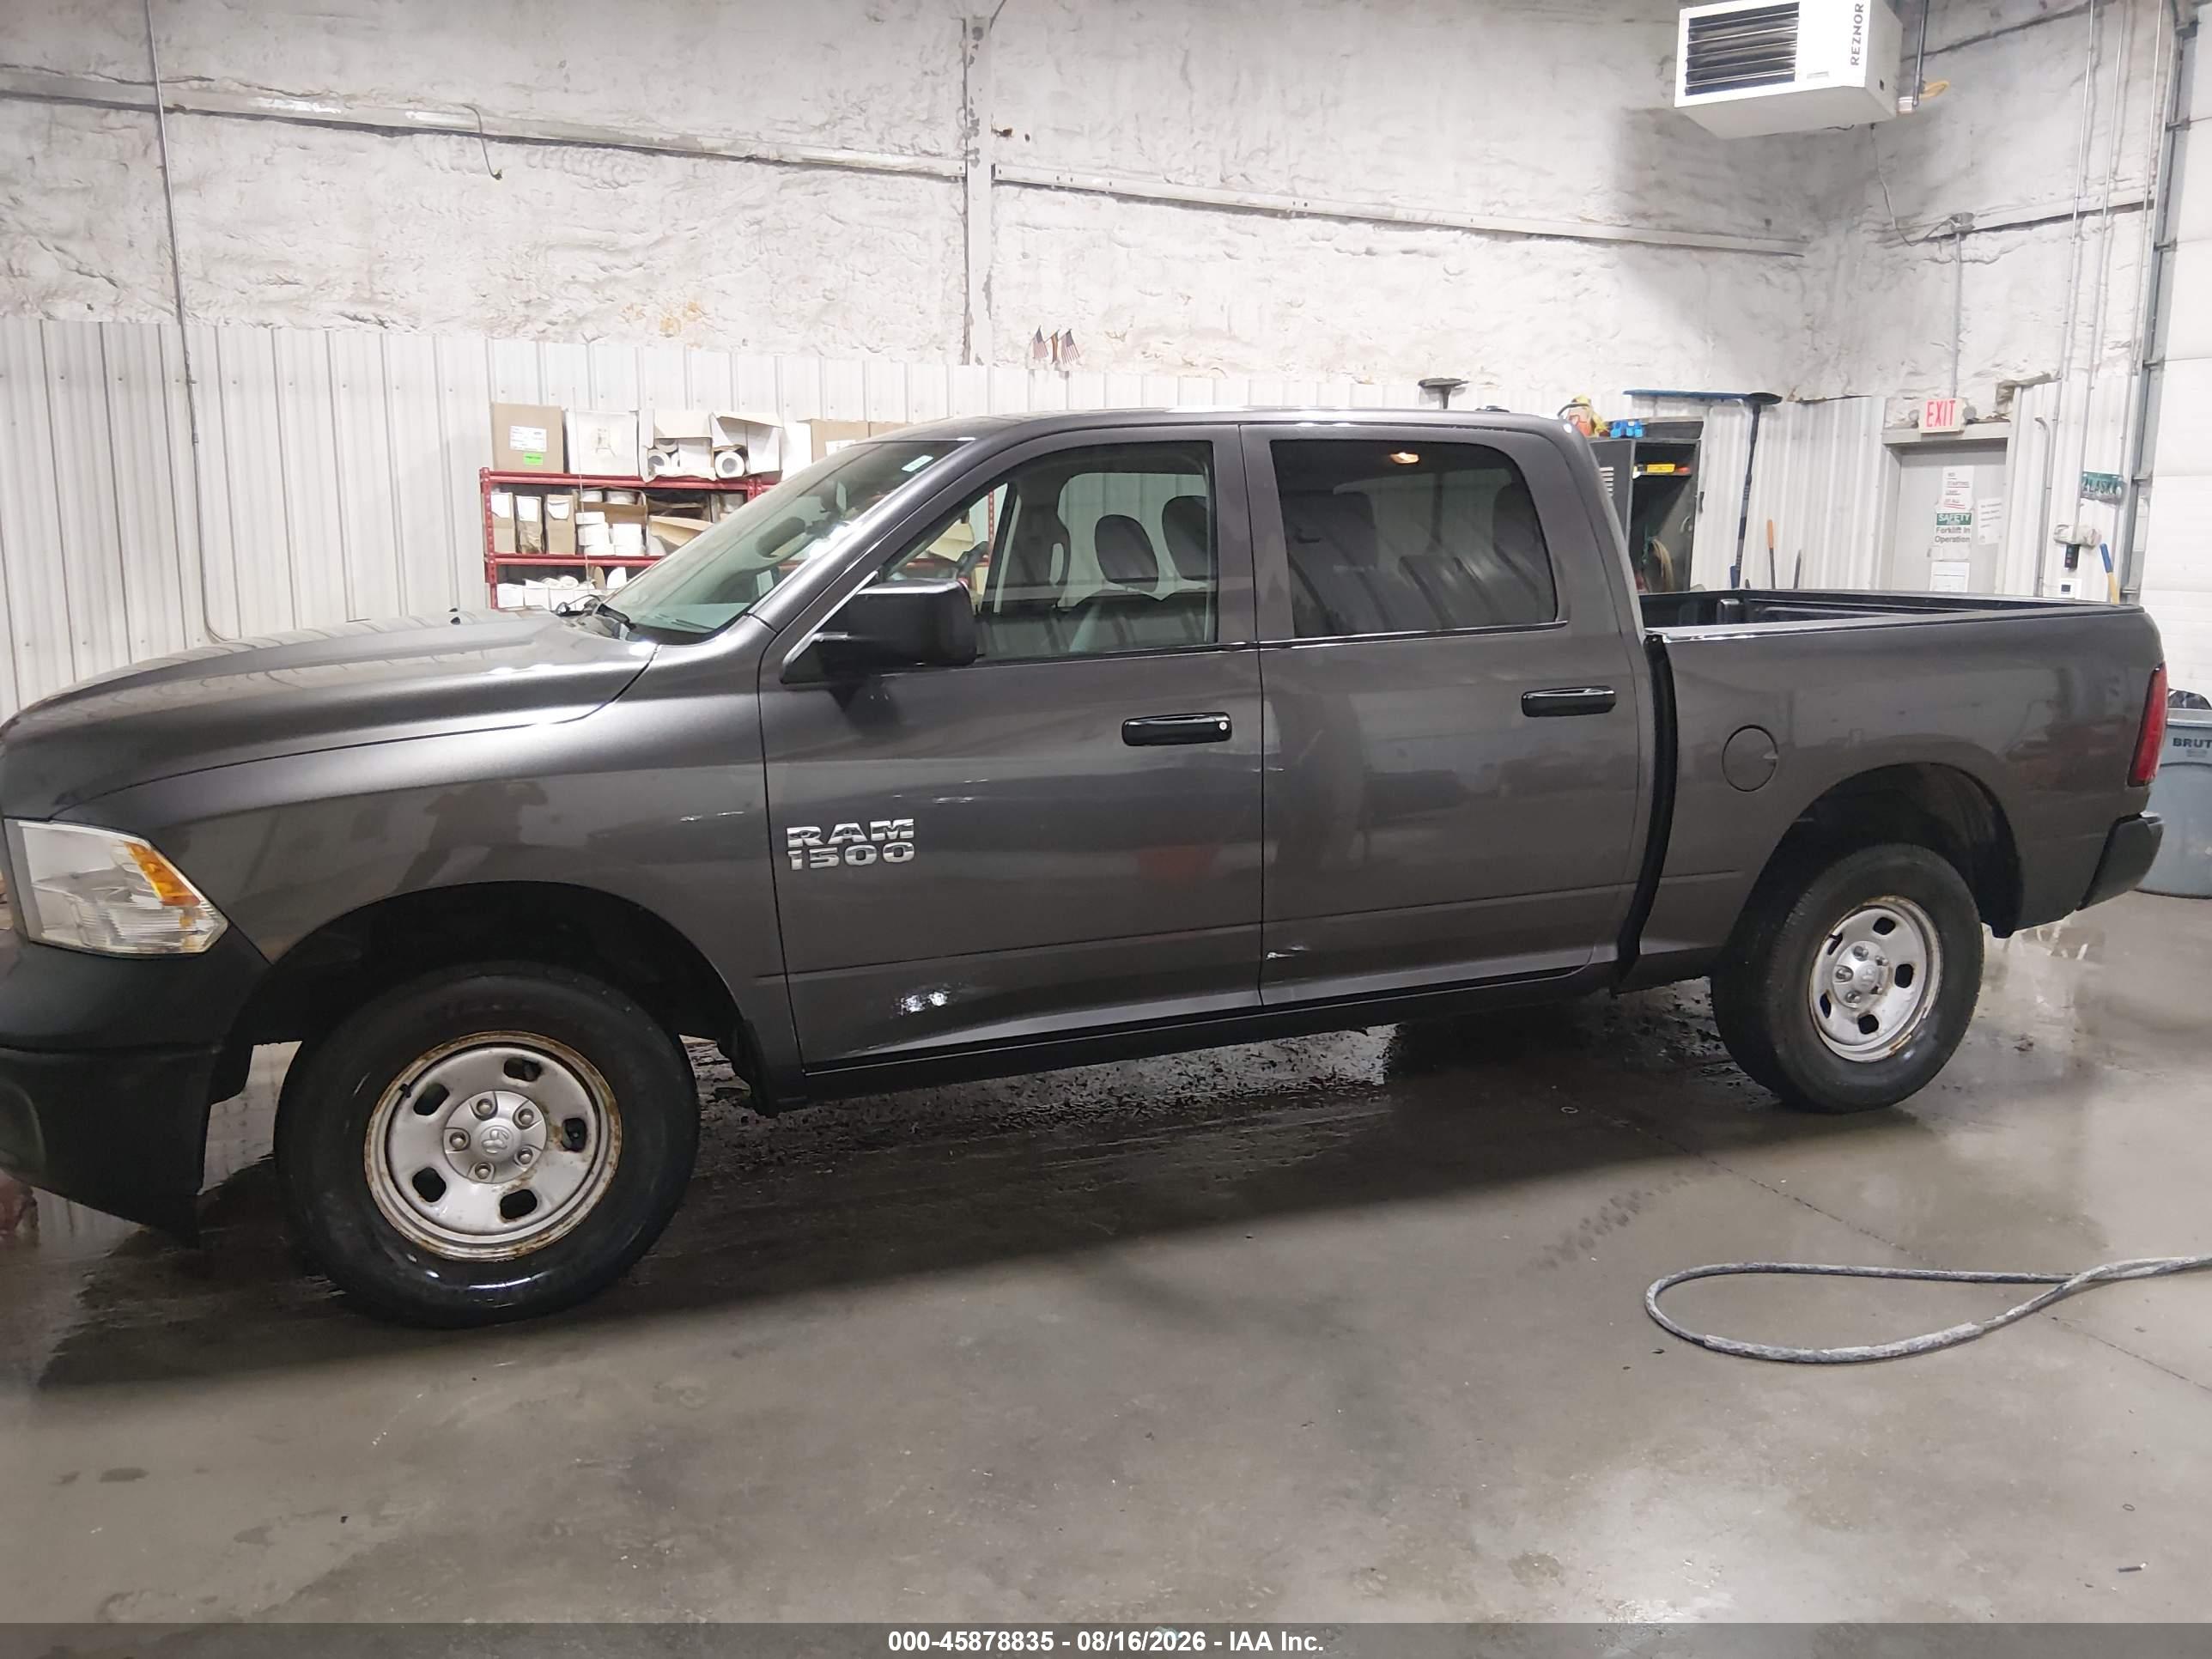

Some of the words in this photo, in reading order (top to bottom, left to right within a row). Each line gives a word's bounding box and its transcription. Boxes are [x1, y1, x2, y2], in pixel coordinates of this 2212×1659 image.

[1850, 3, 1864, 66] REZNOR
[1926, 400, 1956, 427] EXIT
[1938, 514, 1972, 522] SAFETY
[1935, 535, 1971, 544] Operation
[787, 818, 915, 848] RAM
[787, 842, 915, 871] 1500
